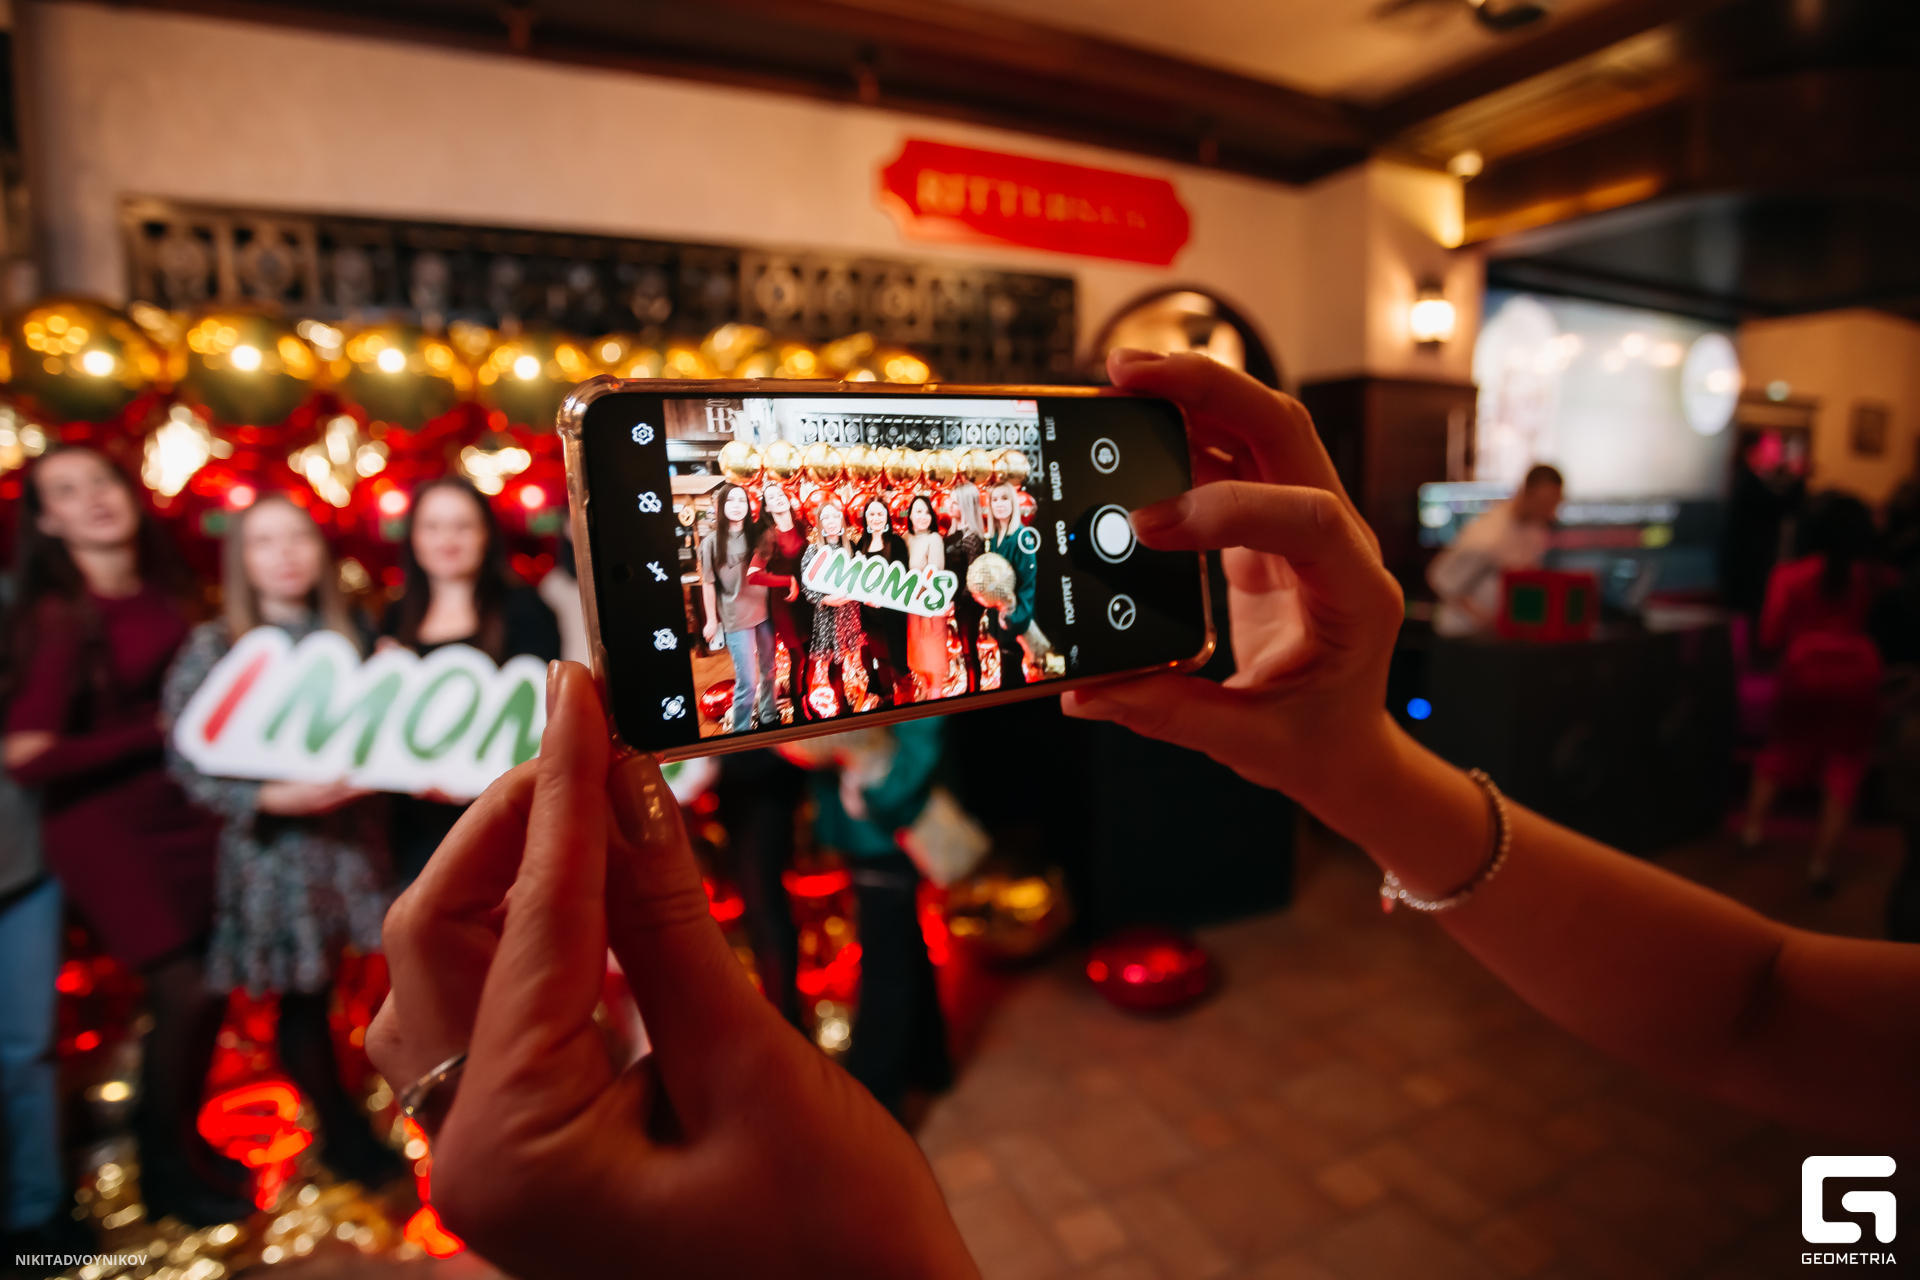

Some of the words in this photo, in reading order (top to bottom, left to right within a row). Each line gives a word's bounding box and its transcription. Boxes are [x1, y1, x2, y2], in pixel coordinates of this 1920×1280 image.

[1049, 461, 1062, 501] ВИДЕО
[1056, 520, 1068, 555] ФОТО
[1061, 575, 1075, 625] ПОРТРЕТ
